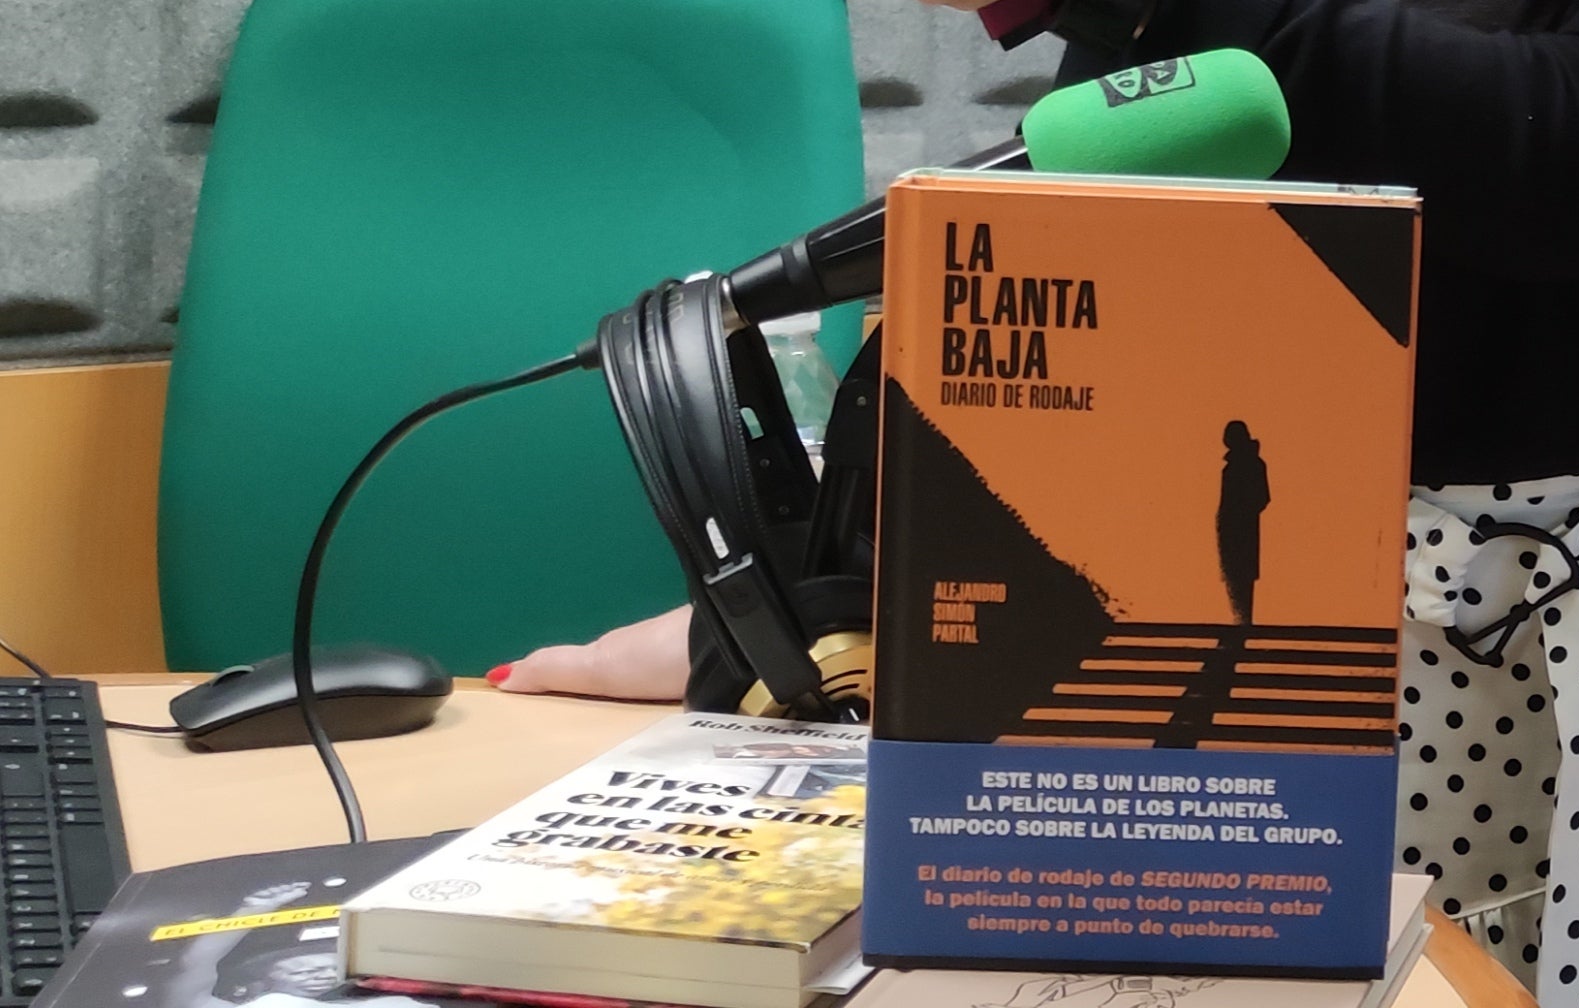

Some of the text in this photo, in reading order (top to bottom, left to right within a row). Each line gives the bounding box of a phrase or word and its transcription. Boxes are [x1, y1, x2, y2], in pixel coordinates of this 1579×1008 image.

[945, 222, 994, 273] LA
[943, 274, 1098, 330] PLANTA
[942, 327, 1048, 380] BAJA
[940, 381, 1095, 411] DIARIO DE RODAJE
[933, 581, 1007, 603] ALEJANDRO
[932, 623, 979, 644] PARTAL
[688, 719, 868, 742] Rob Sheffield
[607, 770, 752, 797] Vives
[982, 771, 1276, 796] ESTE NO ES UN LIBRO SOBRE
[566, 792, 642, 809] en
[646, 795, 734, 817] las
[966, 792, 1289, 820] LA PELÍCULA DE LOS PLANETAS.
[535, 811, 753, 839] que me
[909, 817, 1343, 845] TAMPOCO SOBRE LA LEYENDA DEL GRUPO.
[491, 828, 760, 862] grabaste
[918, 865, 1332, 895] El diario de rodaje de SEGUNDO PREMIO,
[924, 890, 1324, 916] la película en la que todo parecía estar
[967, 915, 1279, 939] siempre a punto de quebrarse.
